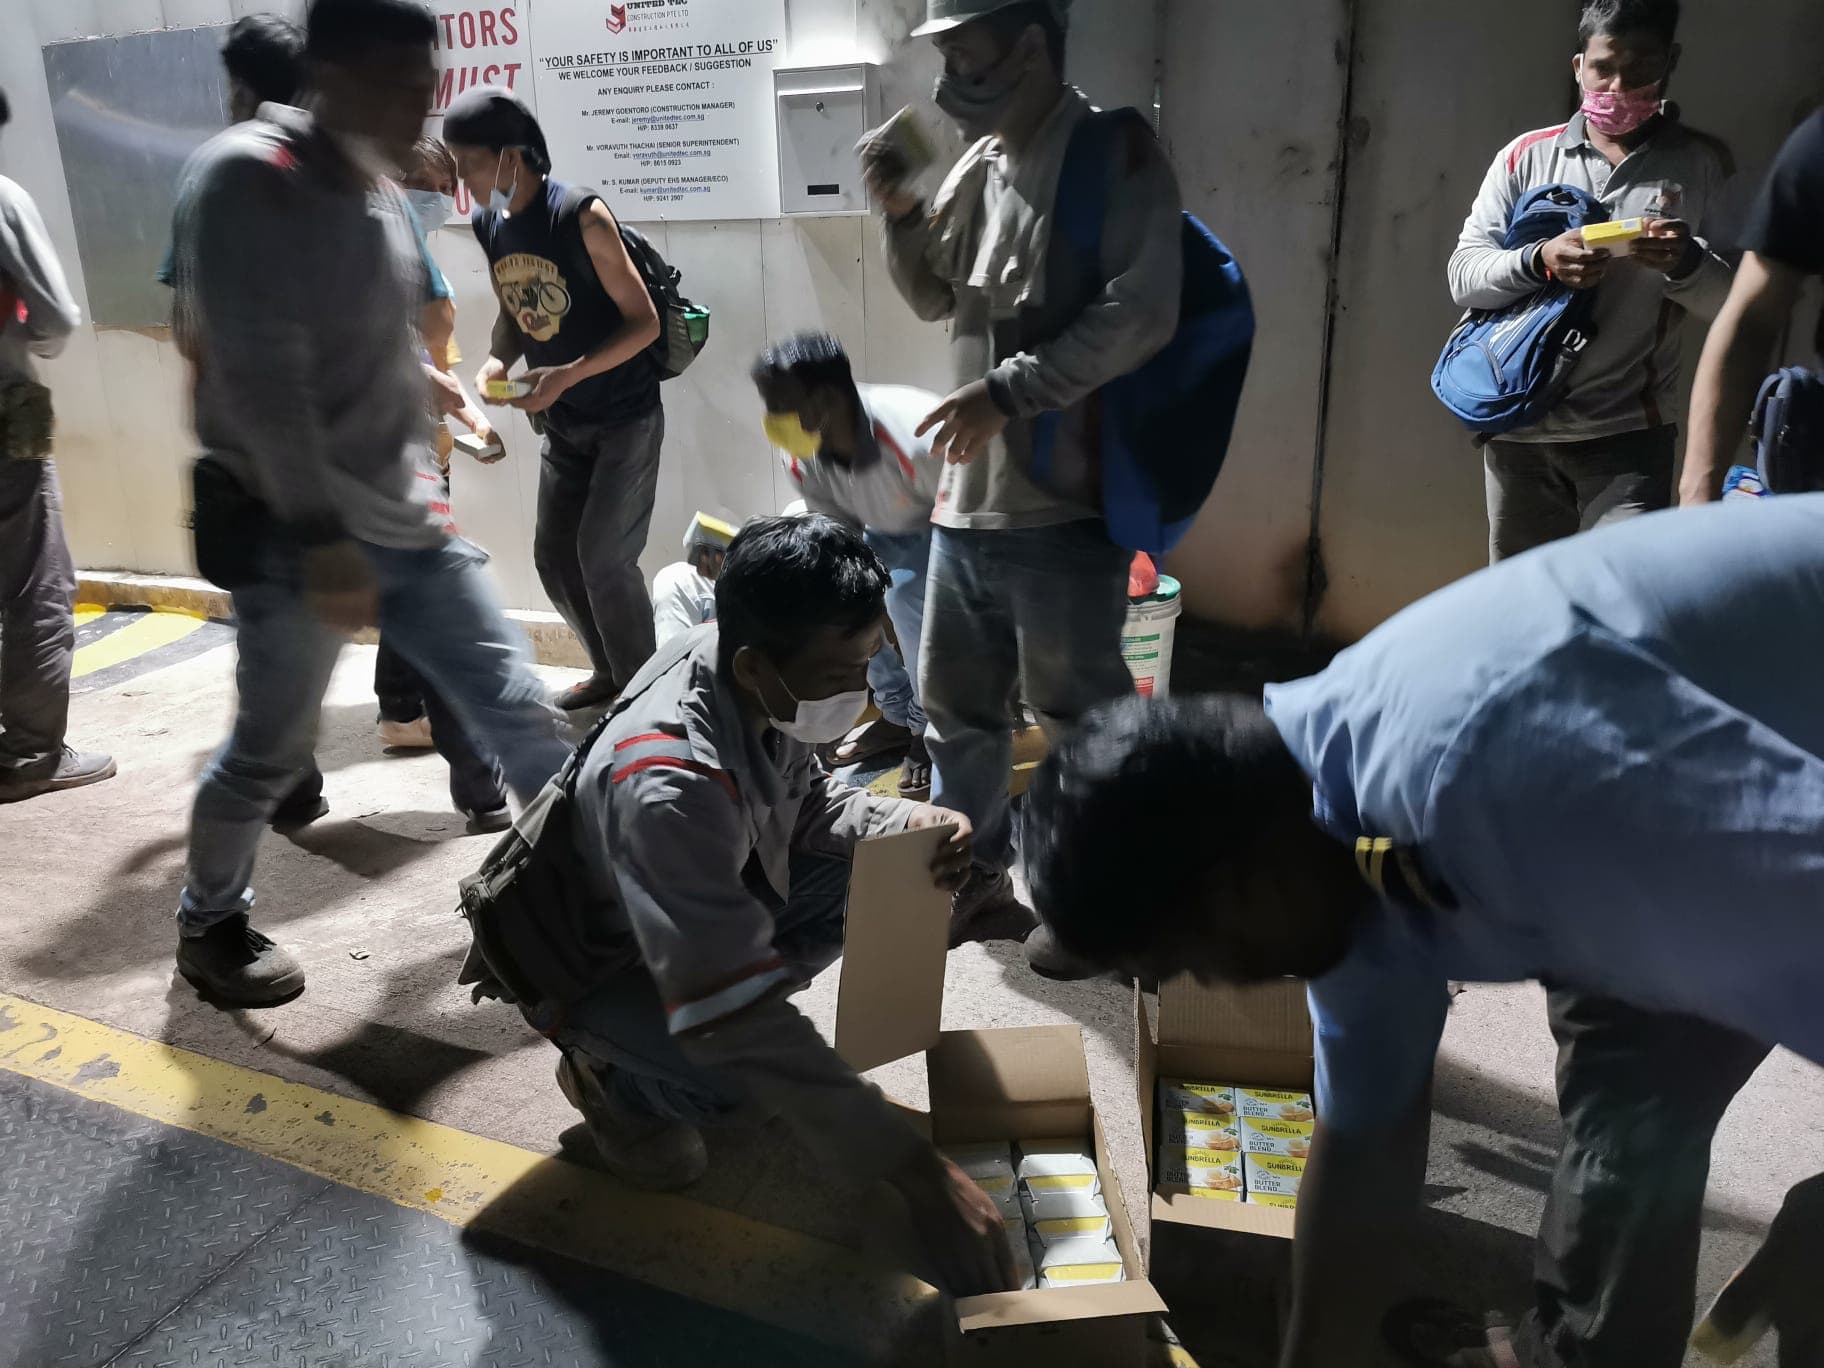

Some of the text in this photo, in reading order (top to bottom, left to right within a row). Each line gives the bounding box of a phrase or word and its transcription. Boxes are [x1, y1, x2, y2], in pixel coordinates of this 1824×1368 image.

[626, 0, 665, 9] UNITED
[627, 9, 689, 21] CONSTRUCTION PTE LTD
[430, 8, 518, 50] ITORS
[576, 52, 617, 66] SAFETY
[619, 50, 629, 62] IS
[631, 45, 694, 61] IMPORTANT
[696, 44, 712, 56] TO
[714, 42, 736, 55] ALL
[738, 41, 754, 53] OF
[558, 71, 572, 81] WE
[573, 68, 614, 80] WELCOME
[616, 66, 640, 77] YOUR
[641, 62, 688, 75] FEEDBACK
[694, 58, 752, 71] SUGGESTION
[597, 88, 612, 96] ANY
[613, 86, 645, 95] ENQUIRY
[646, 83, 674, 93] PLEASE
[675, 81, 711, 91] CONTACT
[591, 108, 615, 116] JEREMY
[650, 103, 701, 115] (CONSTRUCTION
[701, 101, 736, 111] MANAGER)
[611, 116, 631, 124] E-mail:
[596, 143, 628, 151] VORAVUTH
[656, 140, 681, 150] (SENIOR
[682, 138, 740, 148] SUPERINTENDENT)
[641, 177, 667, 186] (DEPUTY
[1261, 1124, 1302, 1135] SUNBRELLA
[1184, 1154, 1221, 1164] UNBRELLA
[1266, 1162, 1302, 1172] SUNBRELL
[1254, 1179, 1281, 1187] BUTTER
